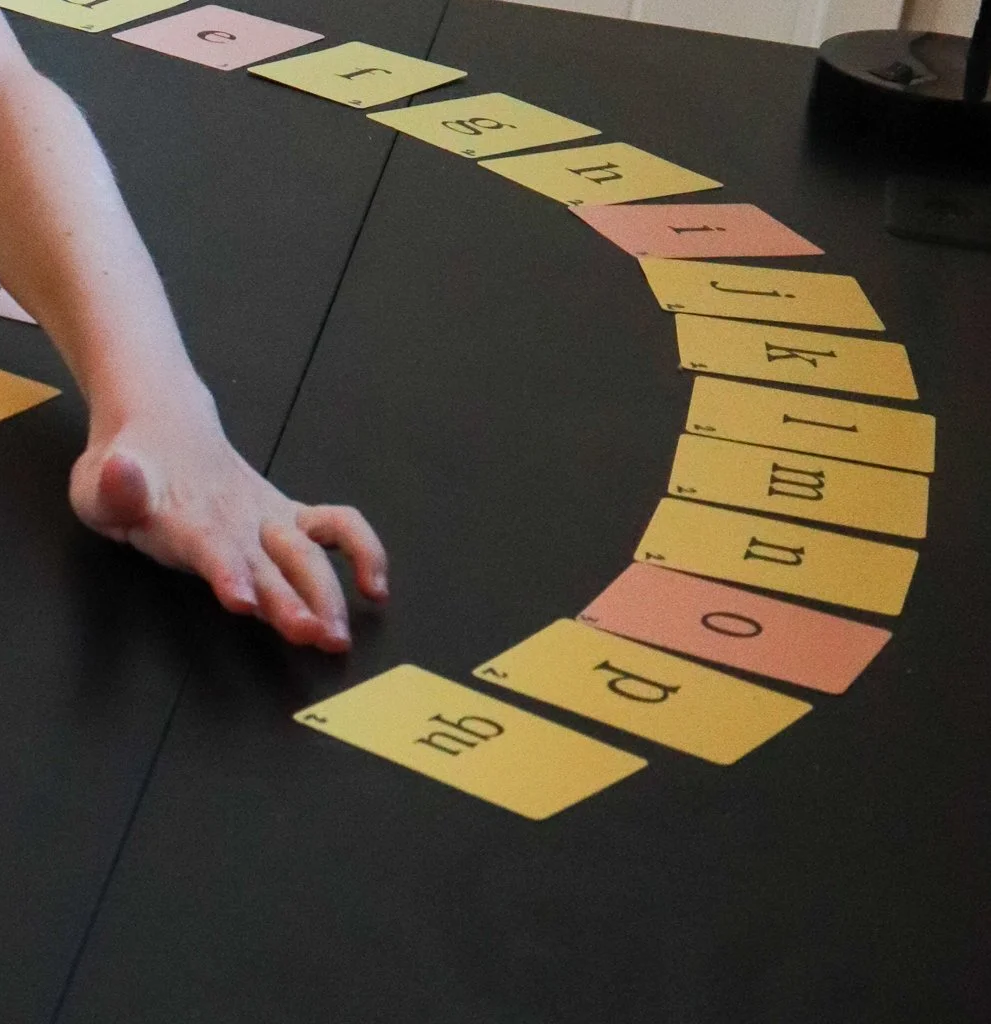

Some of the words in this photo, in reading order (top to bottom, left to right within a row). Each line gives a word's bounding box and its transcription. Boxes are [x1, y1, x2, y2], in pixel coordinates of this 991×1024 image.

[196, 30, 237, 42] e
[334, 66, 394, 81] f
[441, 117, 518, 136] g
[459, 148, 476, 157] 2
[563, 161, 624, 186] h
[566, 198, 585, 207] 2
[667, 224, 727, 235] i
[709, 280, 796, 299] j
[764, 341, 838, 368] k
[693, 423, 717, 432] 2
[782, 413, 859, 433] l
[676, 485, 697, 494] 2
[767, 462, 826, 502] m
[645, 551, 666, 561] 2
[743, 536, 806, 567] n
[700, 611, 764, 639] o
[481, 666, 509, 678] 2
[593, 659, 682, 704] p
[303, 713, 327, 724] 2
[416, 713, 505, 757] qu
